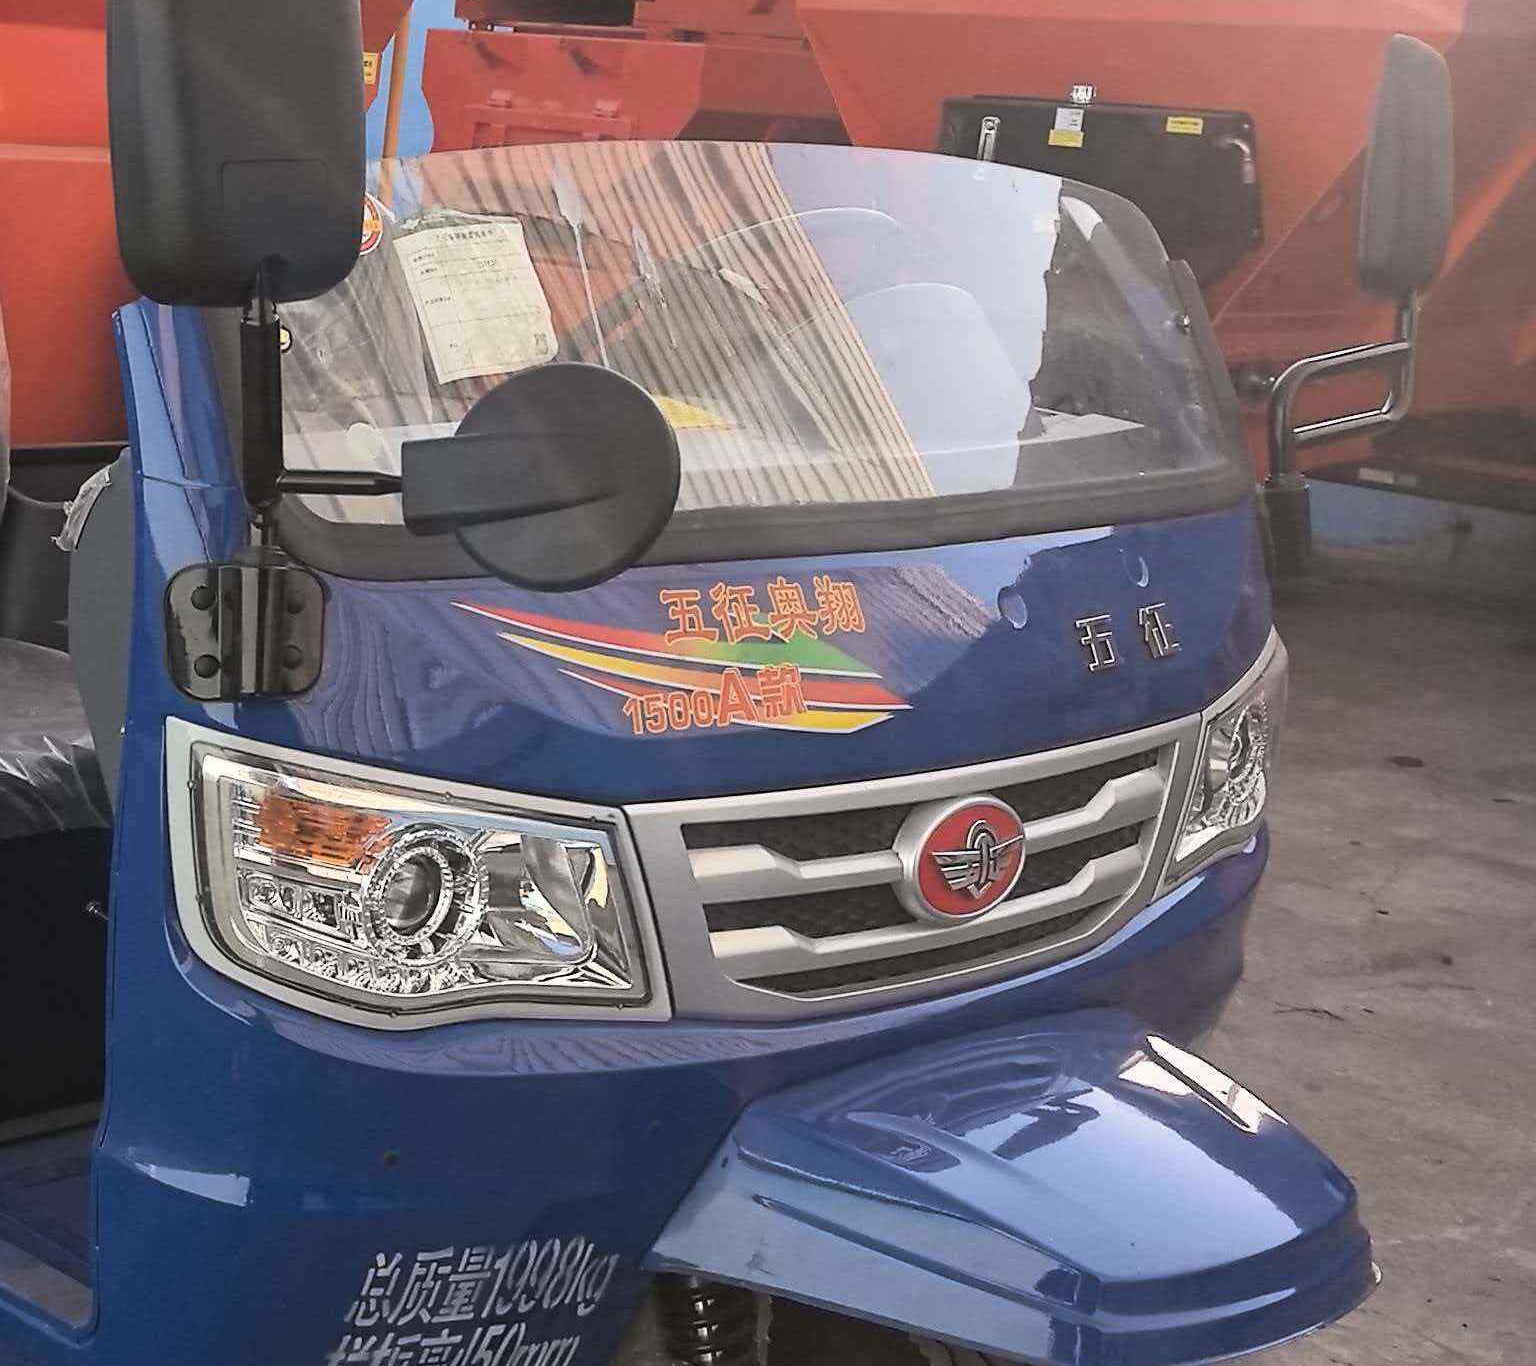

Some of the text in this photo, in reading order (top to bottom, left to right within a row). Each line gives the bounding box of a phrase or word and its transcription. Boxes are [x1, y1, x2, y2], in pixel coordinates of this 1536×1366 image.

[659, 574, 866, 645] 五征奥翔
[622, 662, 808, 736] 1500A款
[344, 1235, 620, 1317] 总质量1998kg
